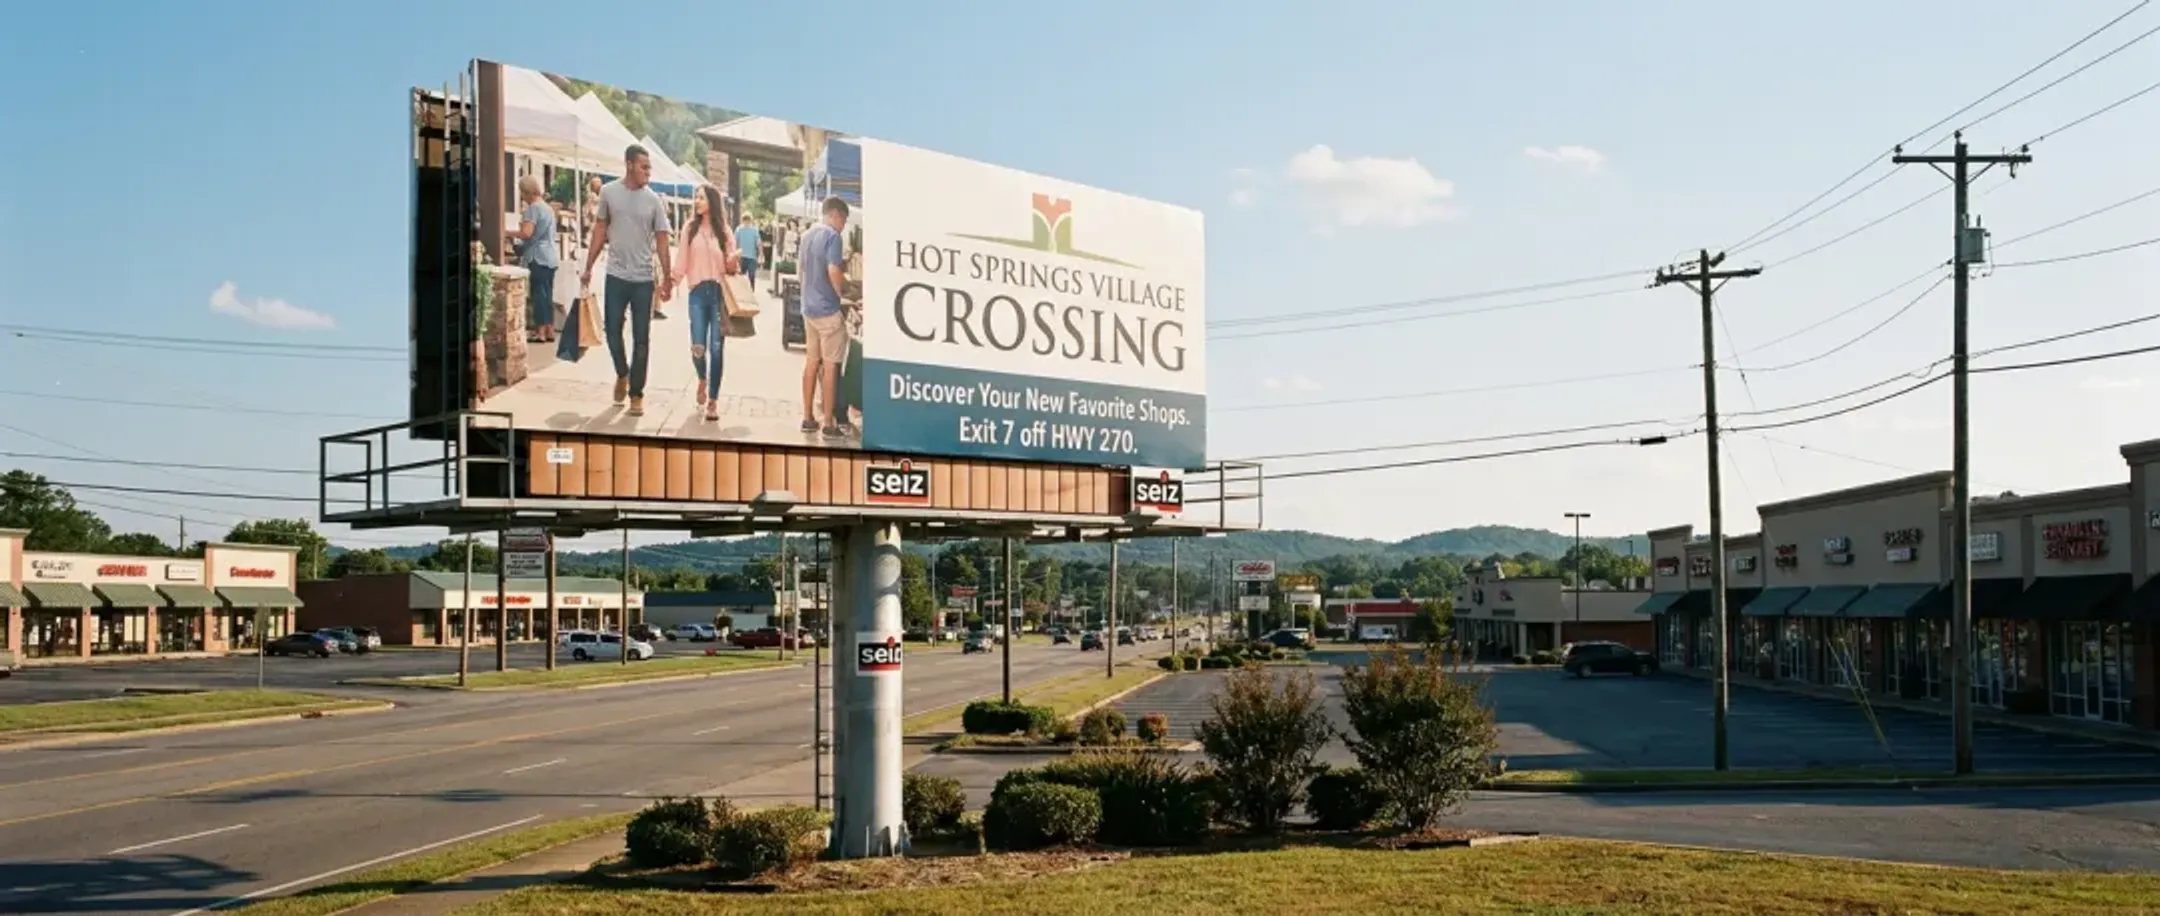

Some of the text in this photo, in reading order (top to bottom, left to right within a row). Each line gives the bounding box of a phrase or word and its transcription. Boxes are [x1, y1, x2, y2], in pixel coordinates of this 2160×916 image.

[895, 240, 1185, 312] HOT SPRINGS VILLAGE
[893, 282, 1186, 372] CROSSING
[890, 373, 1191, 430] Discover Your New Favorite Shops.
[959, 416, 1138, 453] Exit 7 off HWY 270.
[871, 462, 924, 495] seiz
[1137, 471, 1179, 503] seiz
